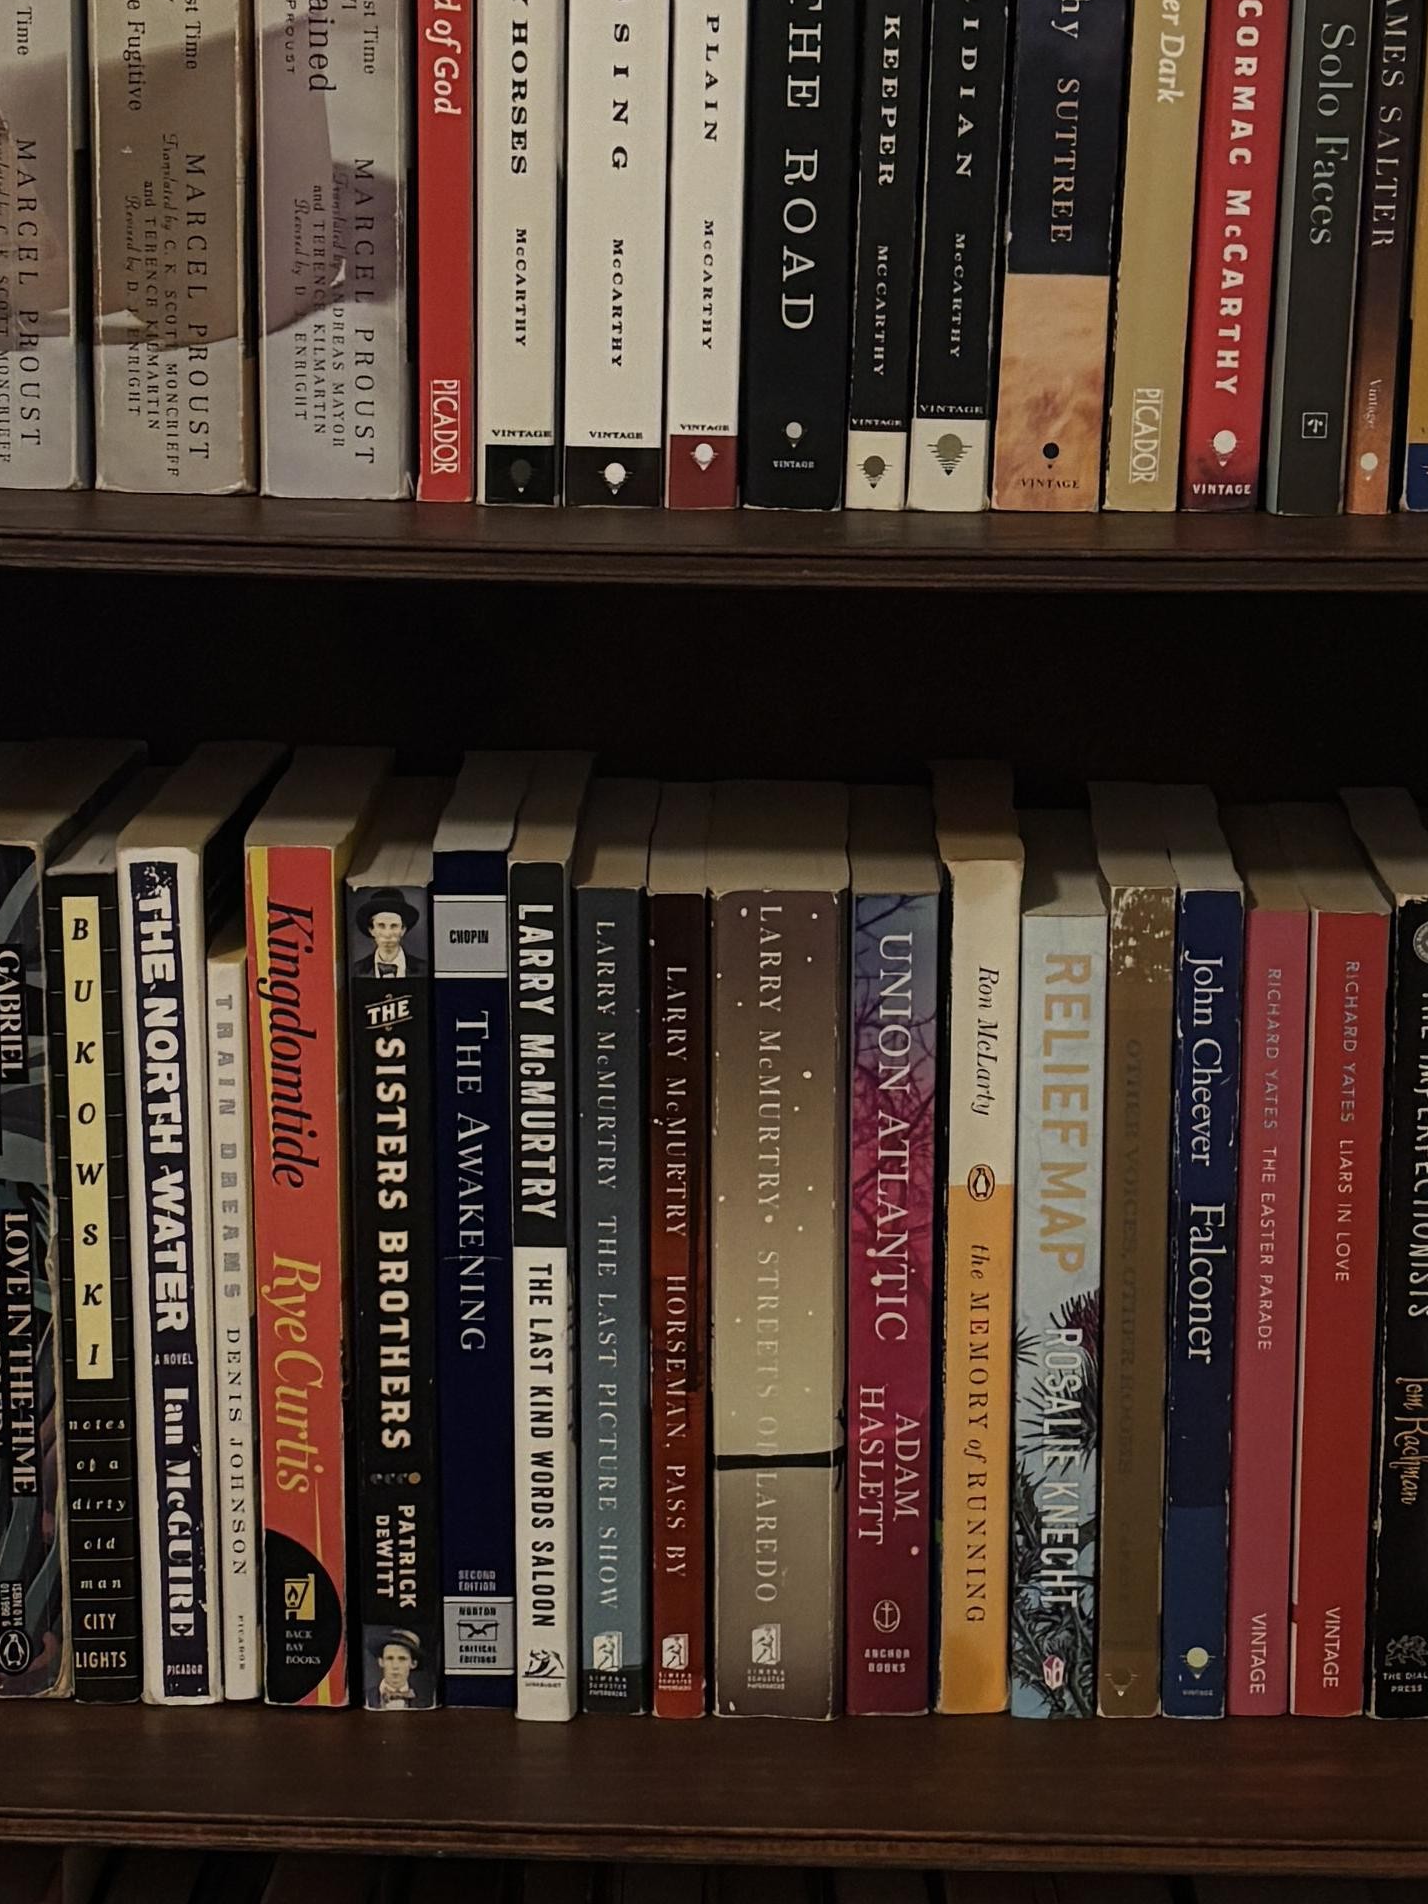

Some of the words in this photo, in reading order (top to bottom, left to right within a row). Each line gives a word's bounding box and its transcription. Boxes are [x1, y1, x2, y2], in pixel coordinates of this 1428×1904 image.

[424, 19, 461, 53] of
[1315, 23, 1356, 116] Solo
[432, 56, 461, 115] God
[1308, 137, 1349, 245] Faces
[780, 148, 819, 331] ROAD
[431, 379, 458, 474] PICADOR
[589, 431, 643, 440] VINTAGE
[517, 903, 555, 1016] LARRY
[255, 898, 319, 1188] Kingdomtide
[878, 933, 913, 1092] UNION
[1041, 953, 1092, 1146] RELIEF
[875, 1109, 911, 1341] ATLANTIC
[1040, 1162, 1087, 1273] MAP
[261, 1255, 322, 1341] Rye
[529, 1264, 553, 1306] THE
[530, 1319, 553, 1375] LAST
[274, 1350, 325, 1494] Curtis
[530, 1386, 554, 1438] KIND
[530, 1451, 554, 1529] WORDS
[531, 1541, 555, 1627] SALOON
[1249, 1613, 1267, 1694] VINTAGE
